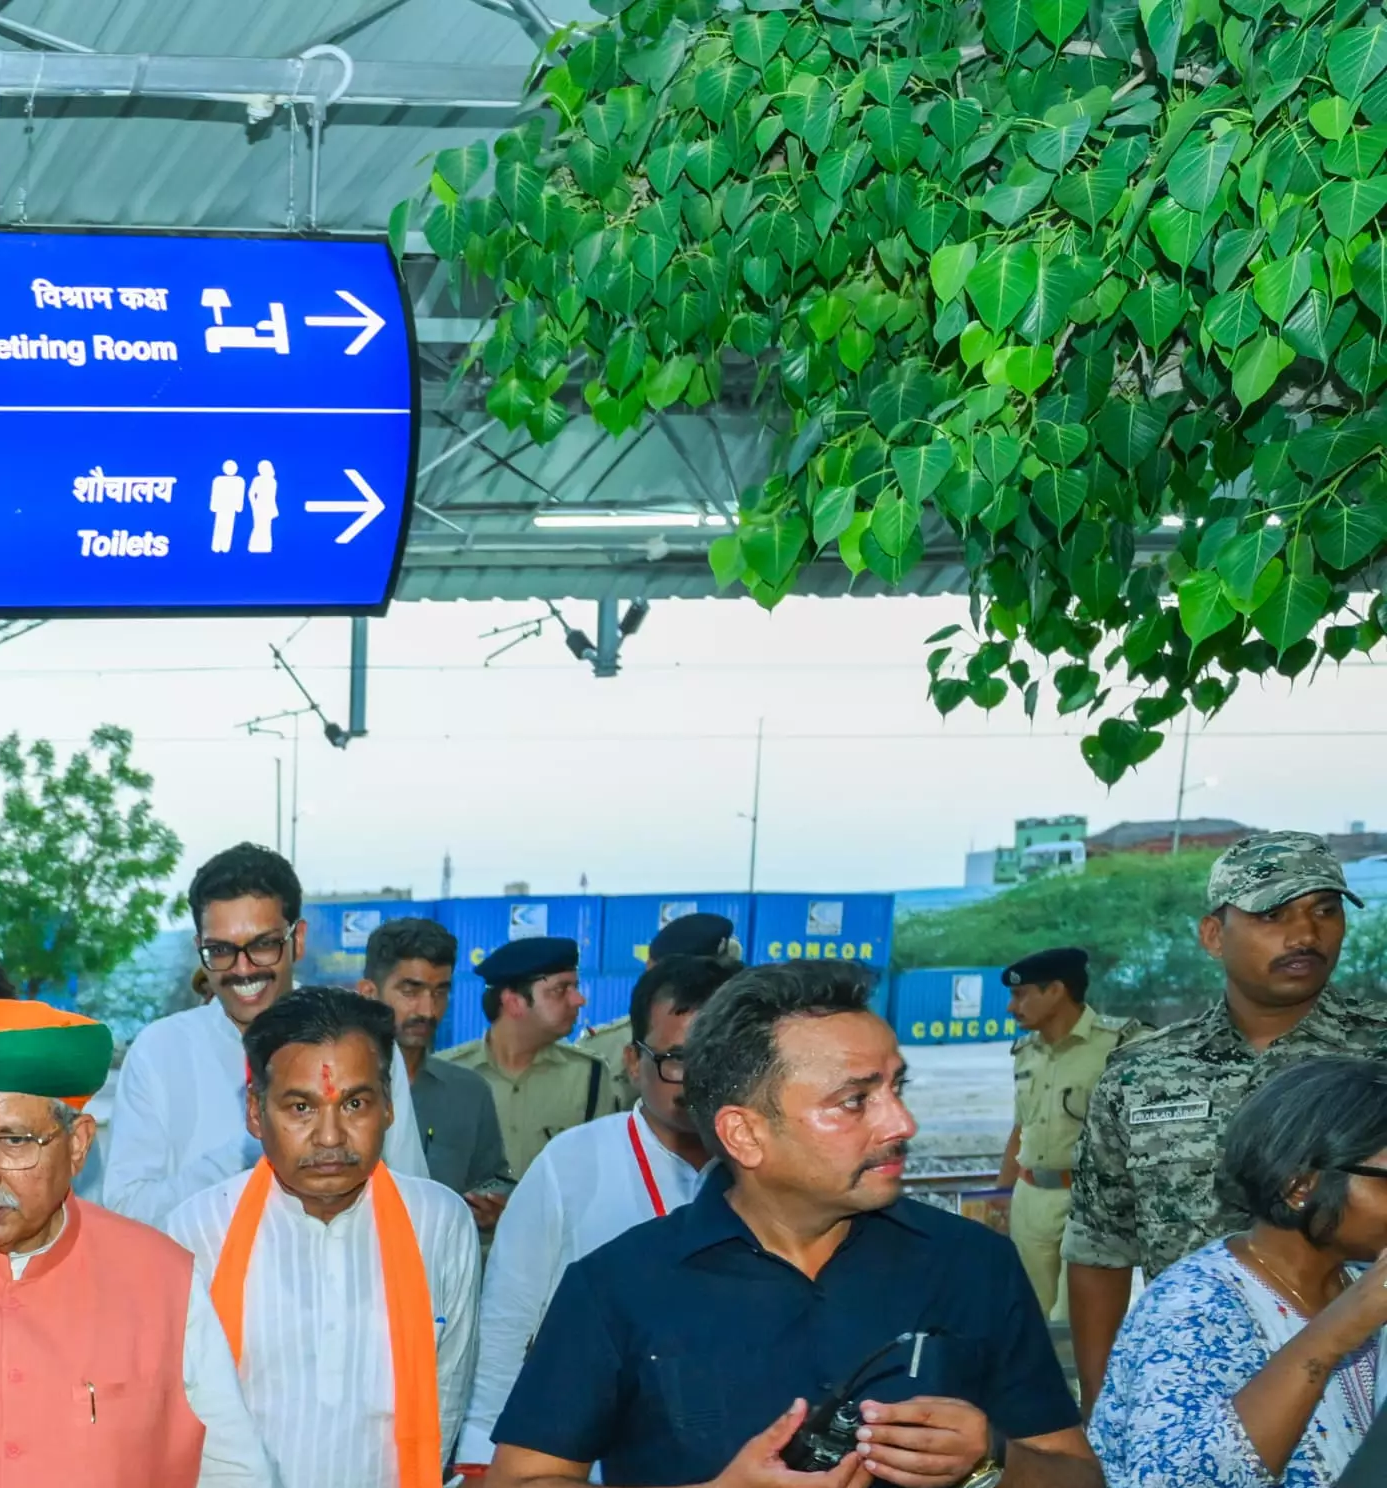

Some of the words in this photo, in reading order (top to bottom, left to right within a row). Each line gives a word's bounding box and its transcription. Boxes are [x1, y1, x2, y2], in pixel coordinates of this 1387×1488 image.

[31, 278, 113, 309] विश्राम
[119, 285, 168, 311] कक्ष
[93, 335, 179, 362] Room
[72, 467, 177, 504] शौचालय
[76, 530, 170, 558] Toilets
